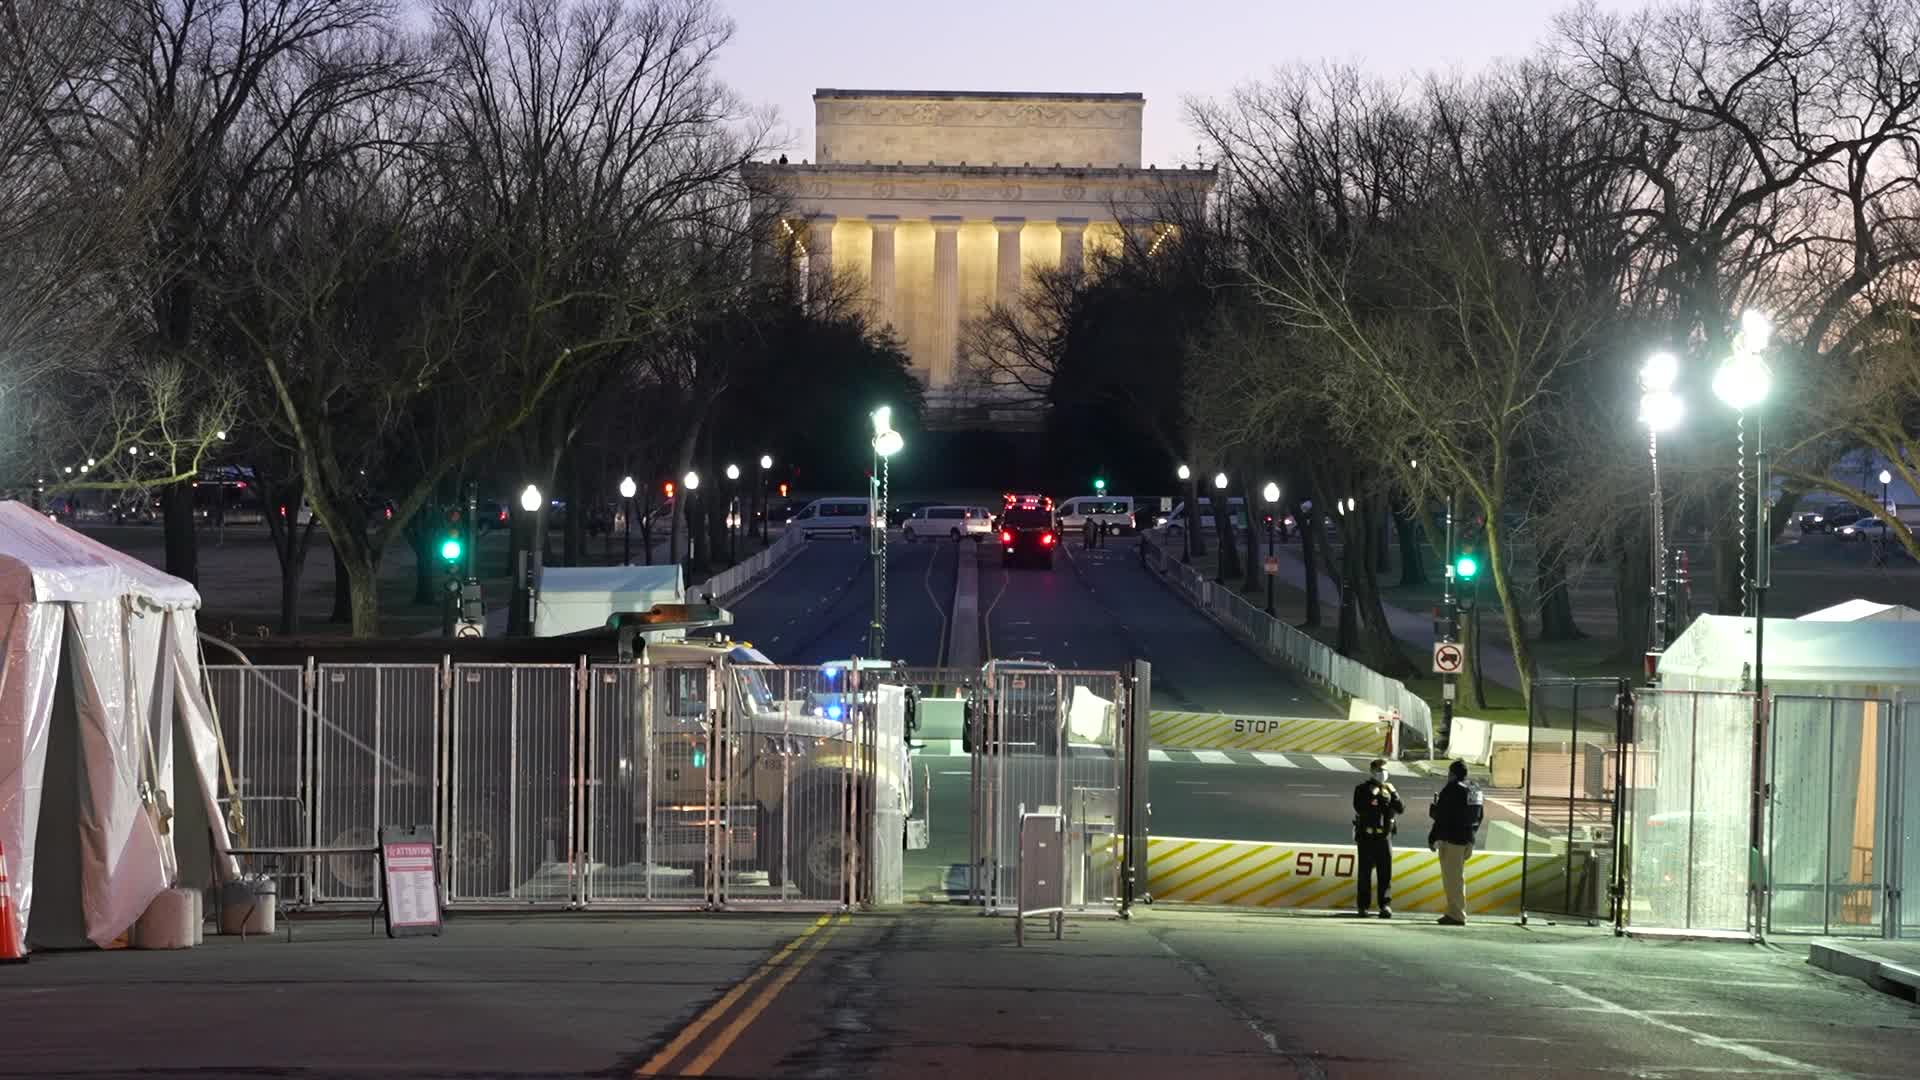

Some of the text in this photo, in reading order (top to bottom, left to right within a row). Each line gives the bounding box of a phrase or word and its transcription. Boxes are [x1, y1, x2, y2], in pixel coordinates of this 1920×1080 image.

[1234, 719, 1279, 733] STOP
[396, 847, 432, 856] ATTENTION
[1295, 852, 1356, 877] STO
